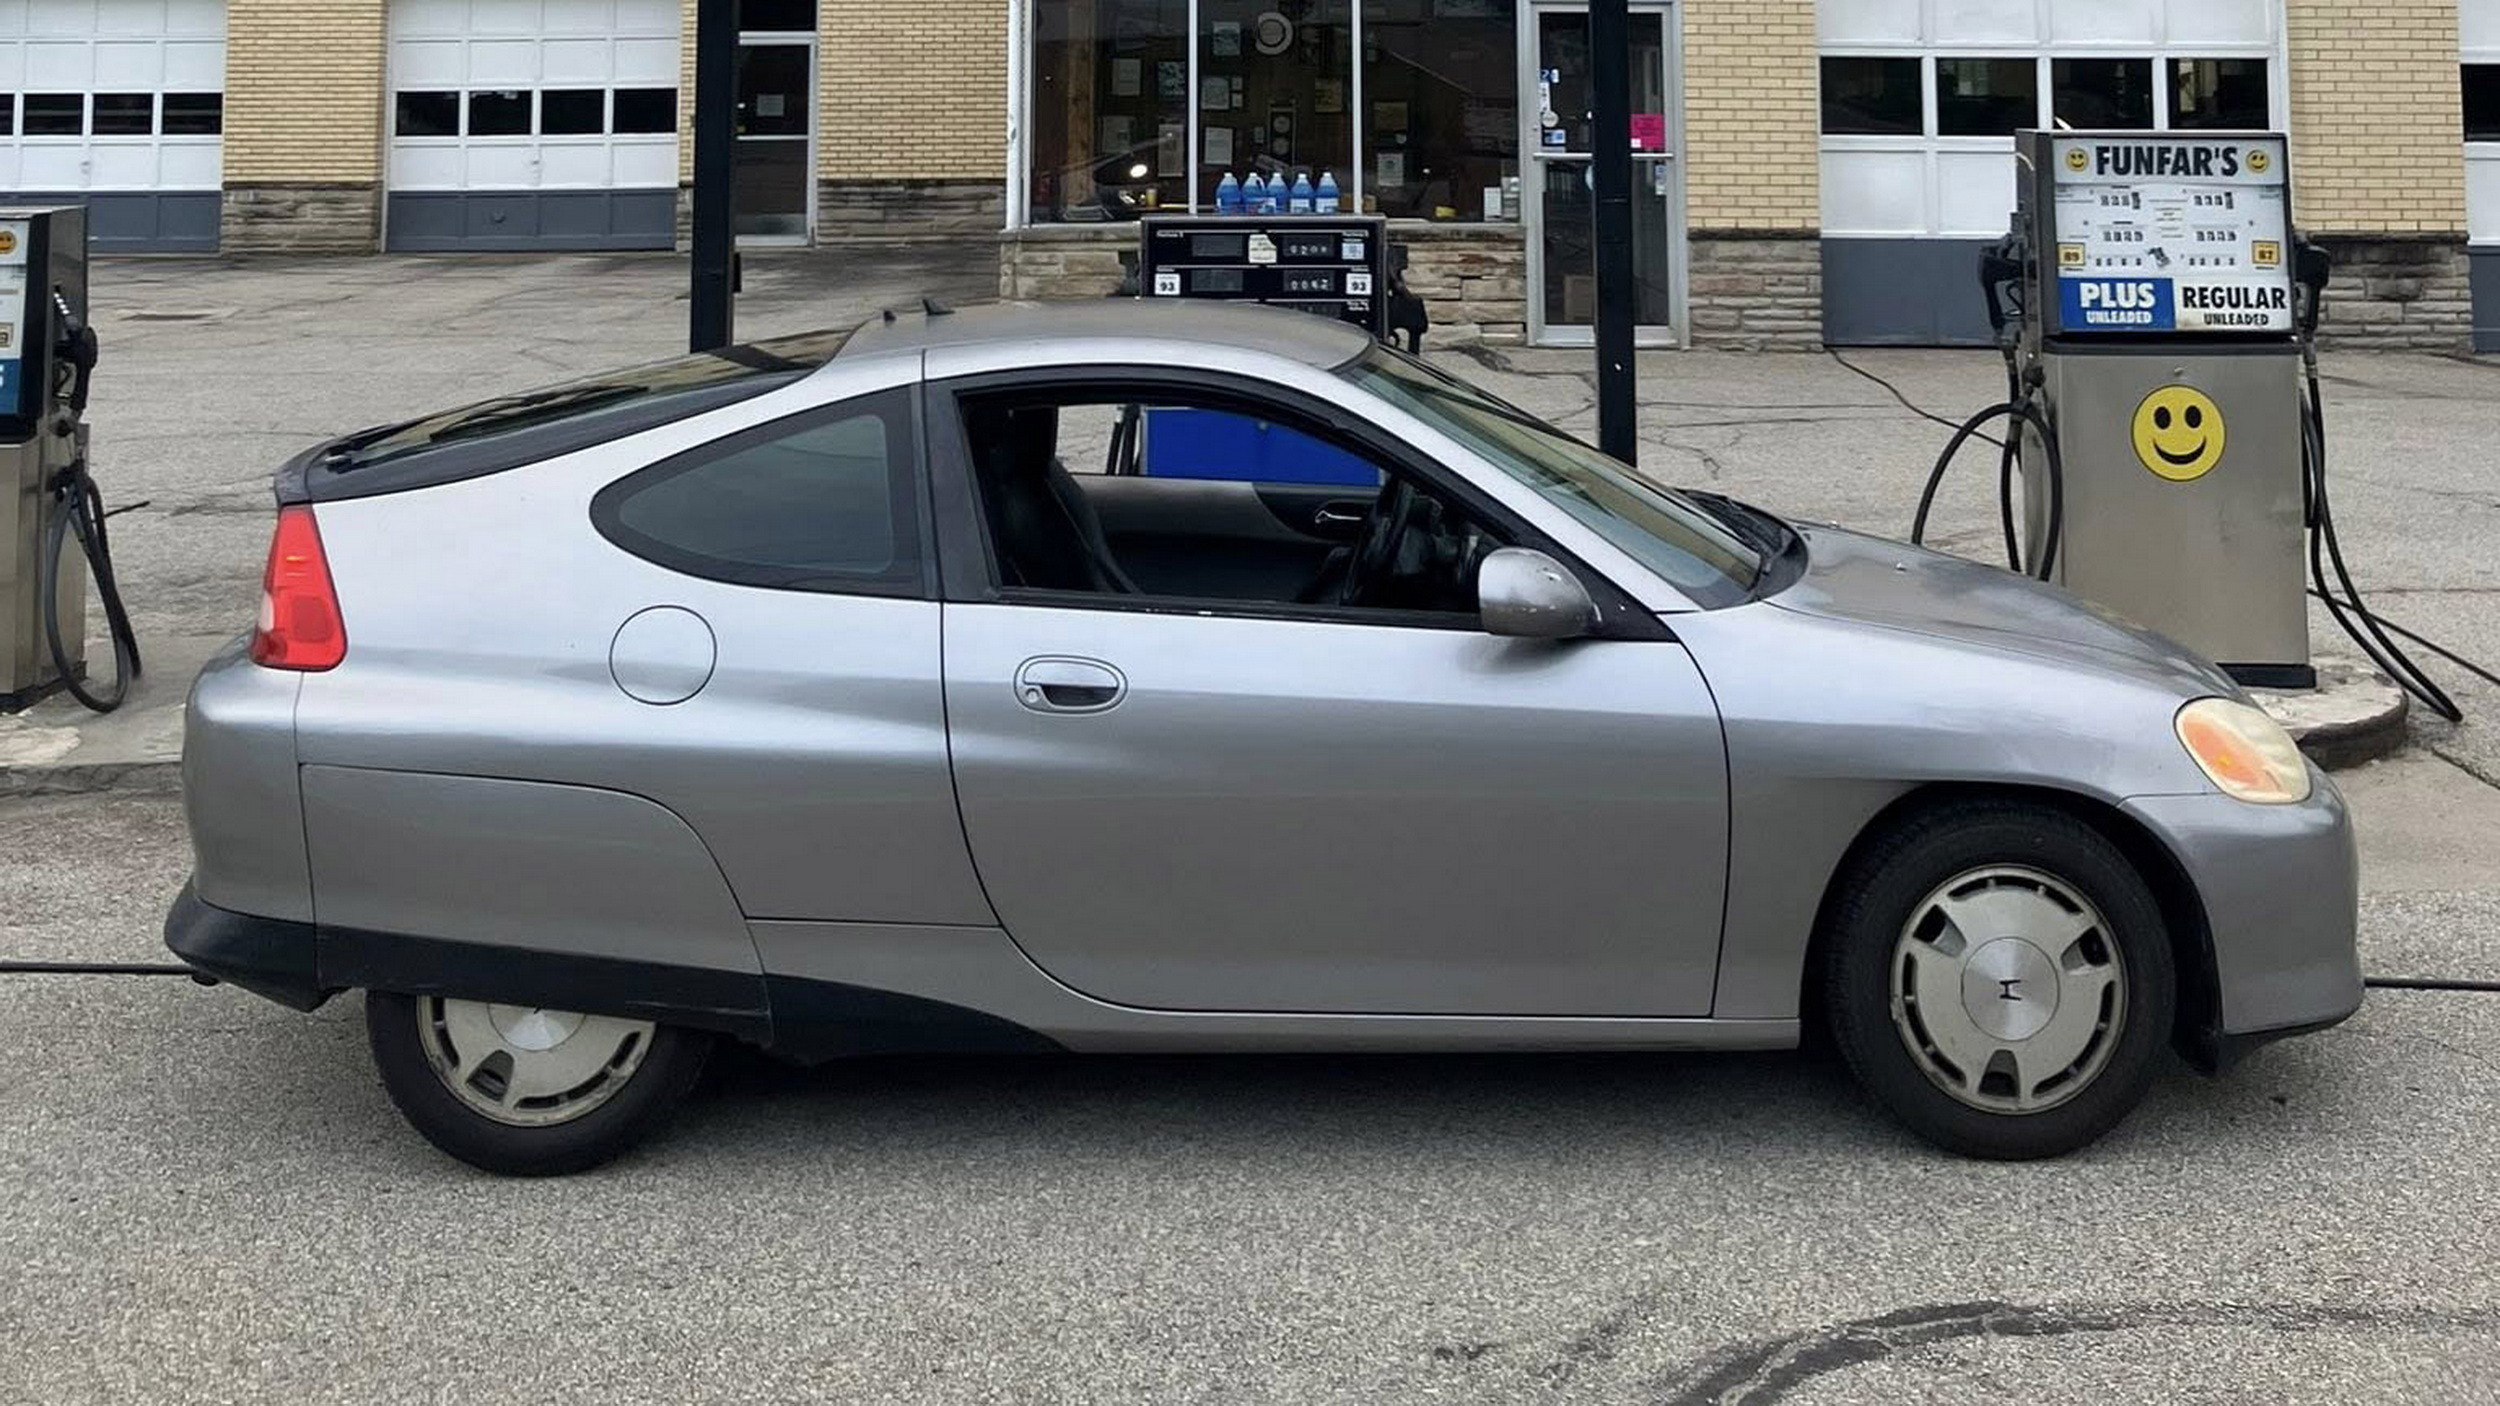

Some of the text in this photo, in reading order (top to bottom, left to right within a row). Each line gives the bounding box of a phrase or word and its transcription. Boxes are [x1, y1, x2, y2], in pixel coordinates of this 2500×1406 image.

[2096, 147, 2238, 176] FUNFAR'S
[1159, 281, 1175, 292] 93
[1350, 281, 1367, 292] 93
[2079, 282, 2156, 308] PLUS
[2183, 287, 2286, 309] REGULAR
[2086, 310, 2153, 324] UNLEADED
[2203, 312, 2270, 327] UNLEADED
